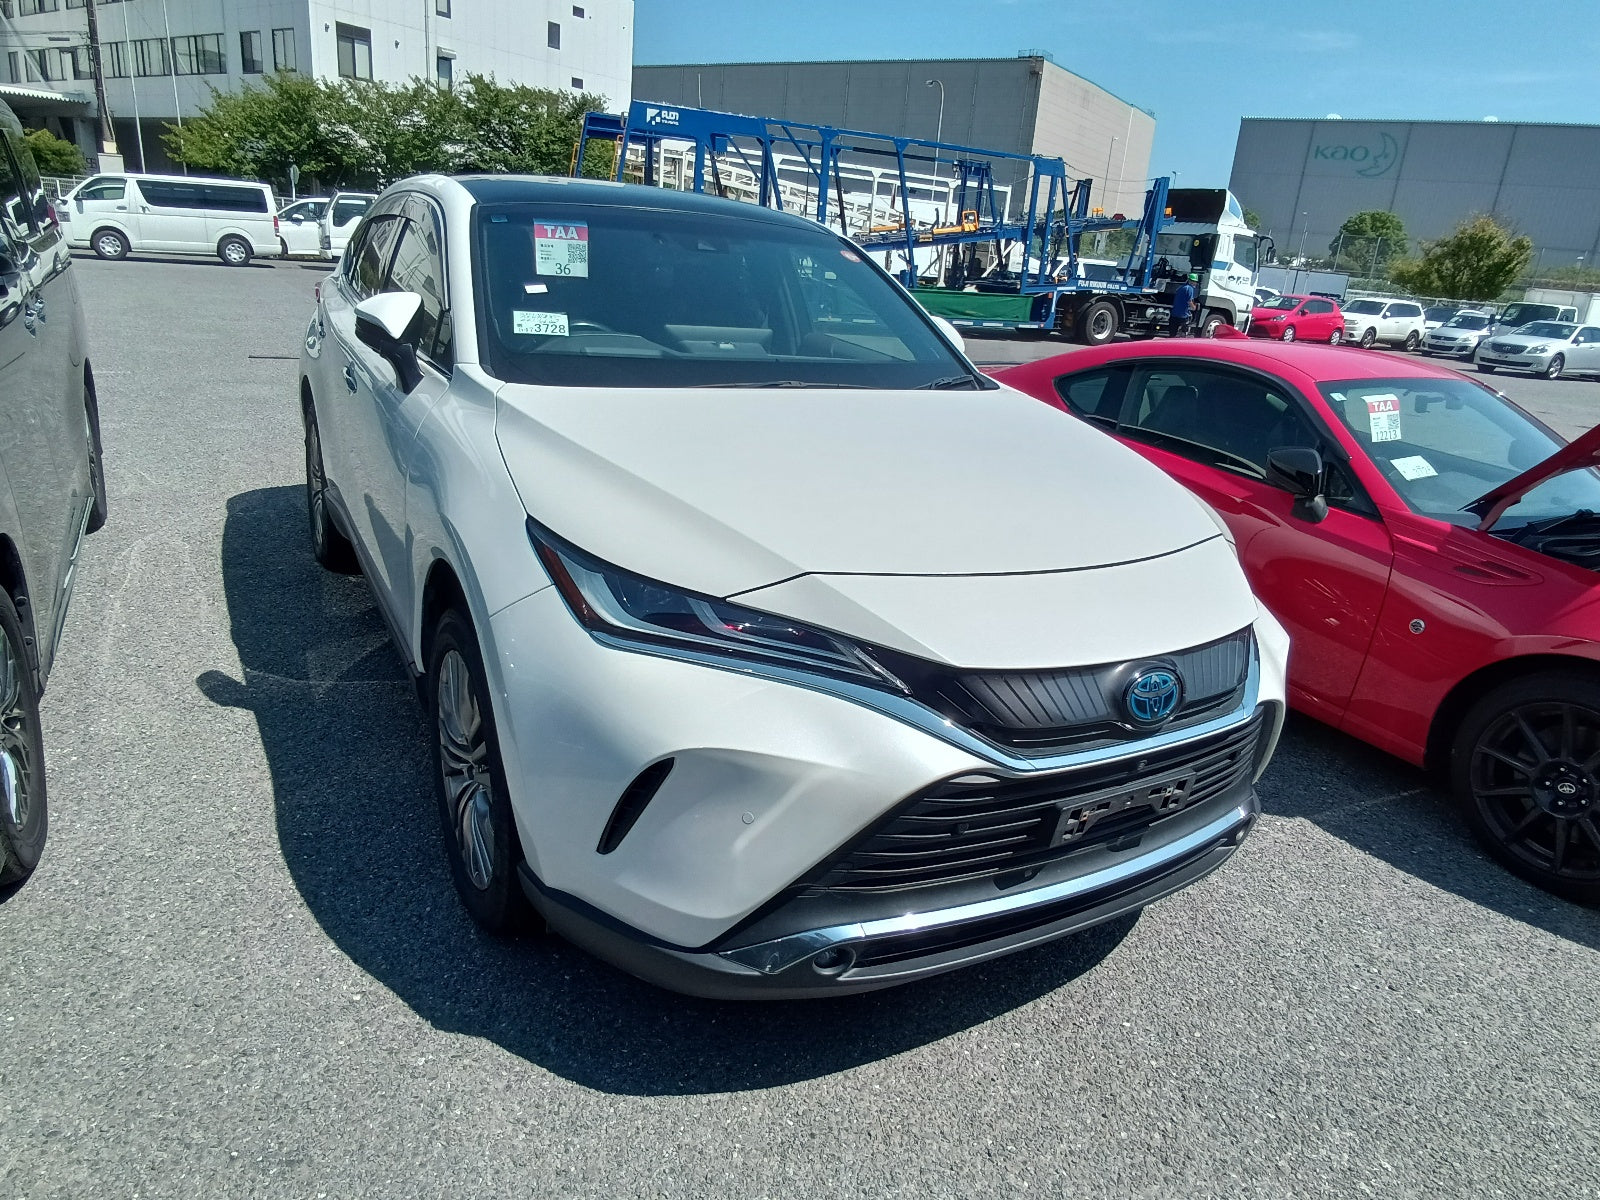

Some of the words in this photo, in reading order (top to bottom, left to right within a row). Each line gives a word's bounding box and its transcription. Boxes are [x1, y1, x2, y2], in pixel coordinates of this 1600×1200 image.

[543, 225, 579, 239] TAA
[555, 263, 571, 275] 36
[534, 323, 566, 334] 3728
[1372, 400, 1394, 412] TAA
[1376, 429, 1398, 441] 12213
